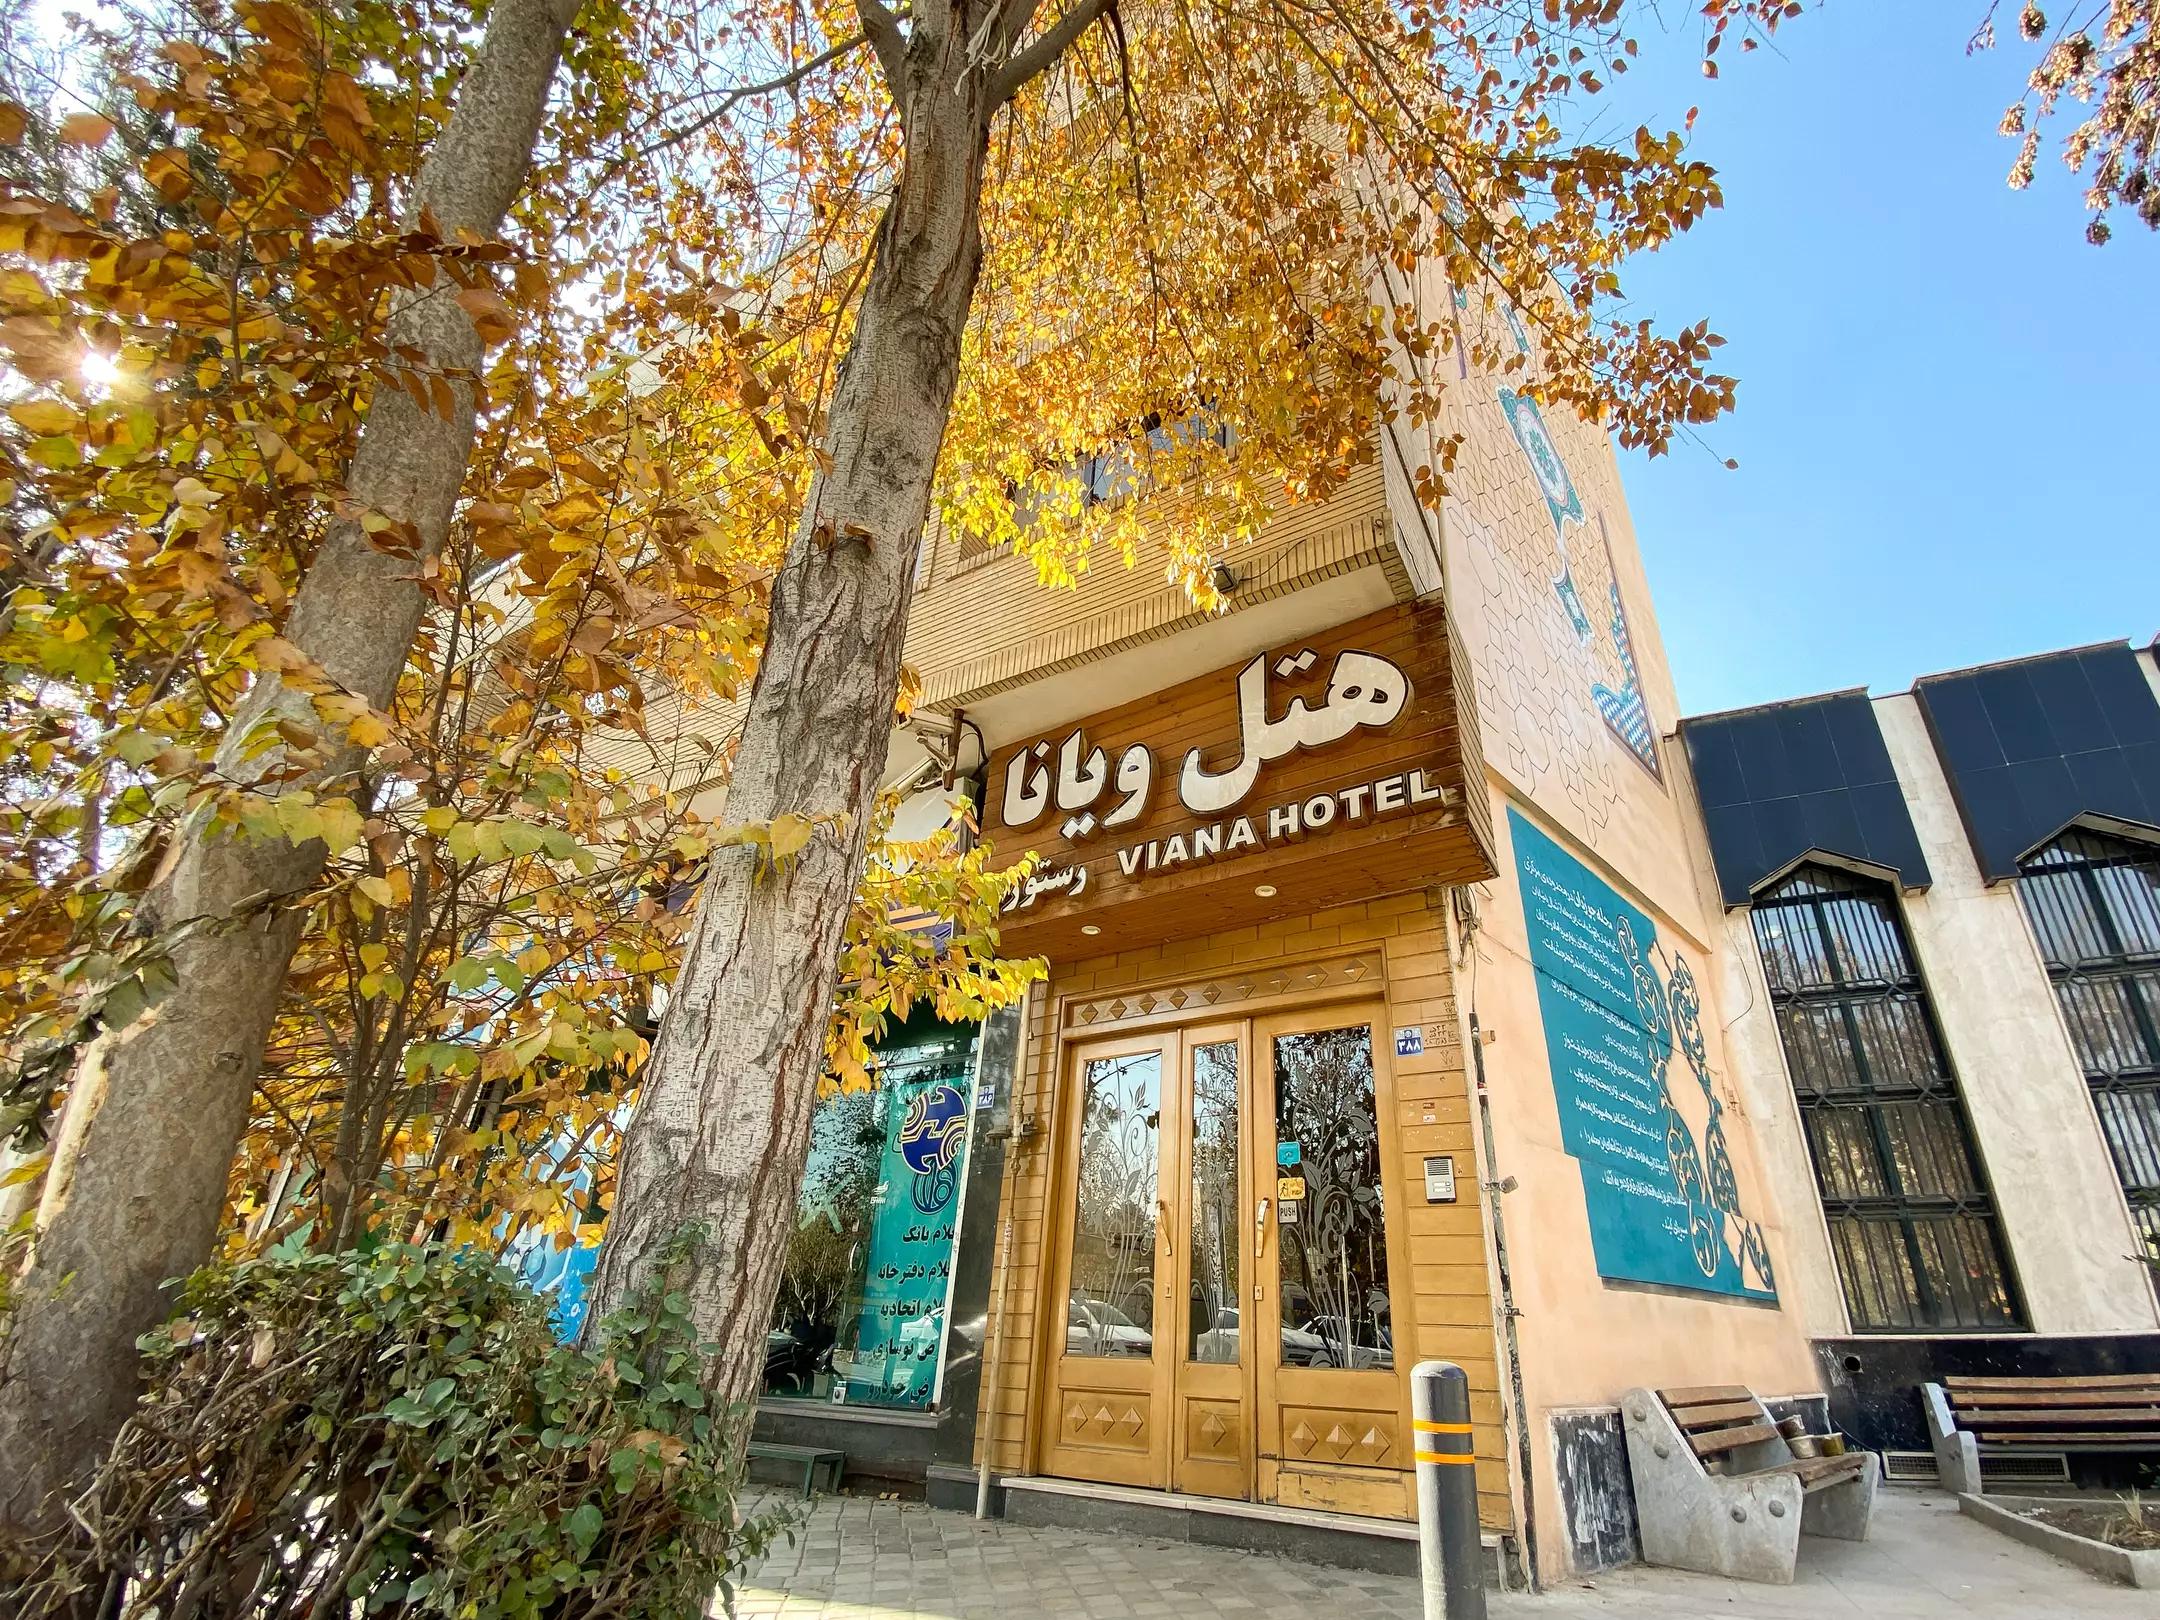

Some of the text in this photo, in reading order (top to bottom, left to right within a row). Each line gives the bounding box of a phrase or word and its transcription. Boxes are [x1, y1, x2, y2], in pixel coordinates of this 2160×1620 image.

[1001, 647, 1413, 840] هتل ویانا
[1117, 768, 1443, 877] VIANA HOTEL
[1597, 908, 1613, 929] محله
[1398, 1039, 1421, 1053] ۳۸۸
[1280, 1207, 1296, 1217] PUSH
[902, 1225, 930, 1247] بانک
[880, 1299, 921, 1320] اتحادیه
